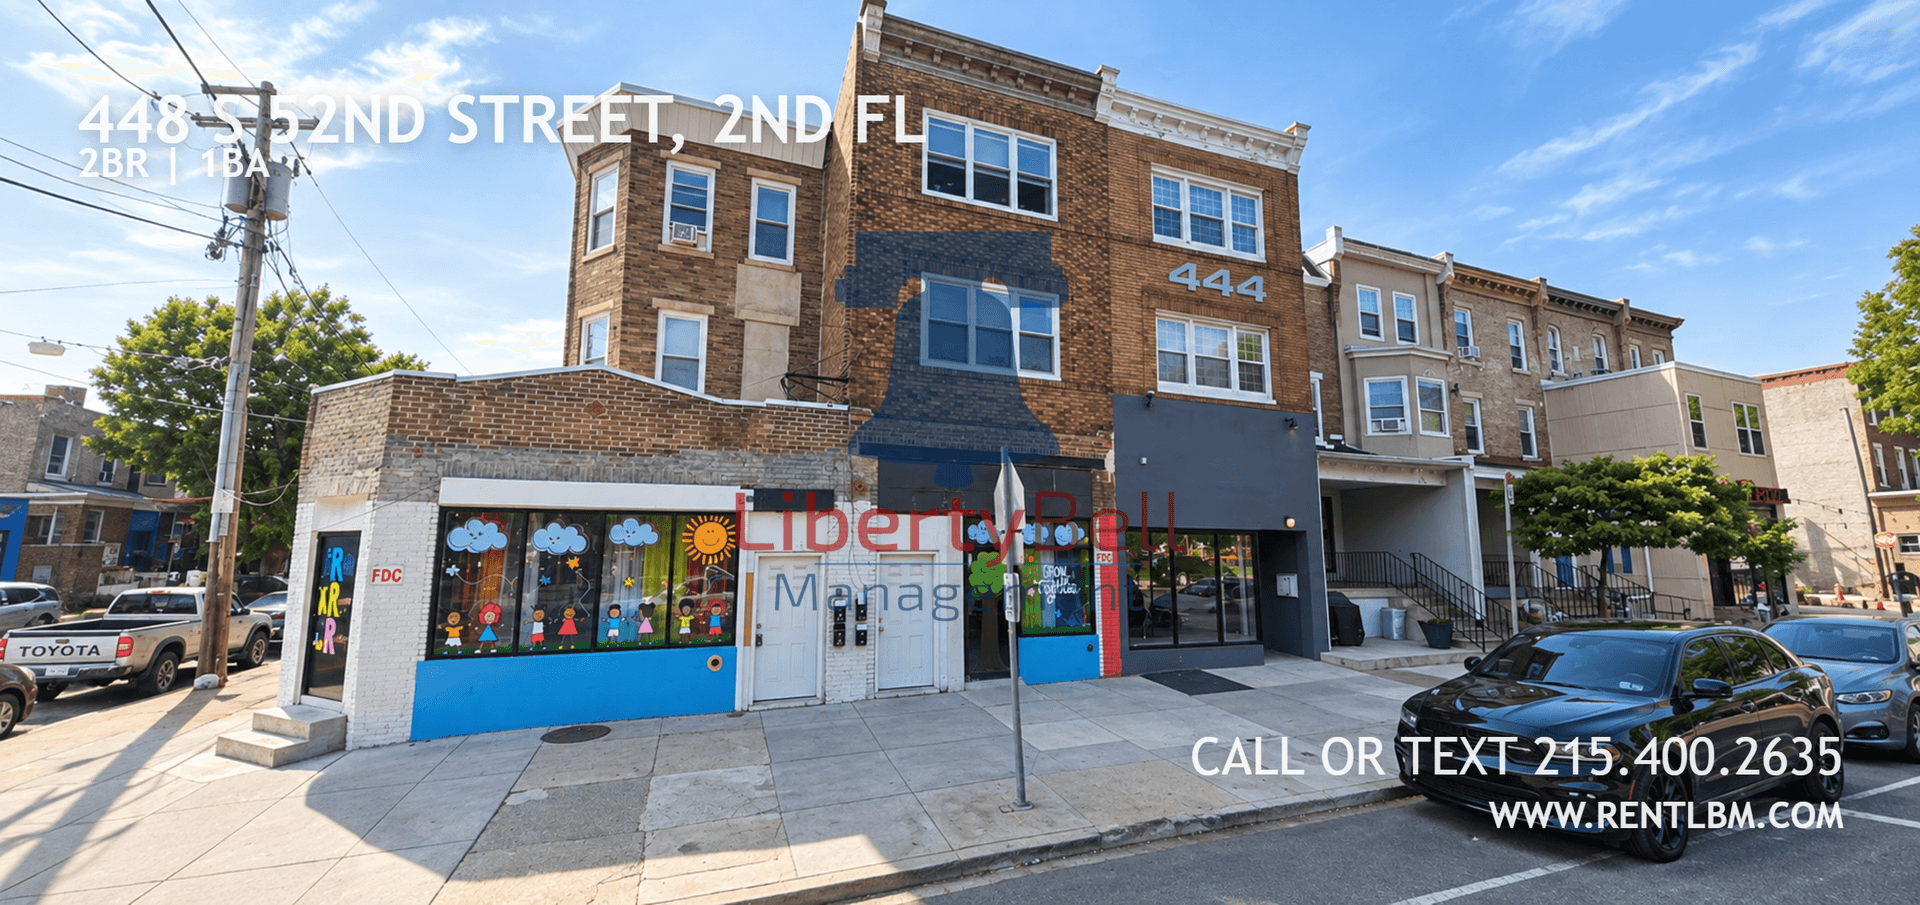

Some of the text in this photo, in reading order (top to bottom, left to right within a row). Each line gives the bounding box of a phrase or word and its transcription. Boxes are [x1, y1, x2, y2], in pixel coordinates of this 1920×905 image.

[1168, 262, 1267, 303] 444
[1096, 553, 1112, 562] FDC
[371, 568, 403, 583] FDC
[19, 645, 101, 657] TOYOTA
